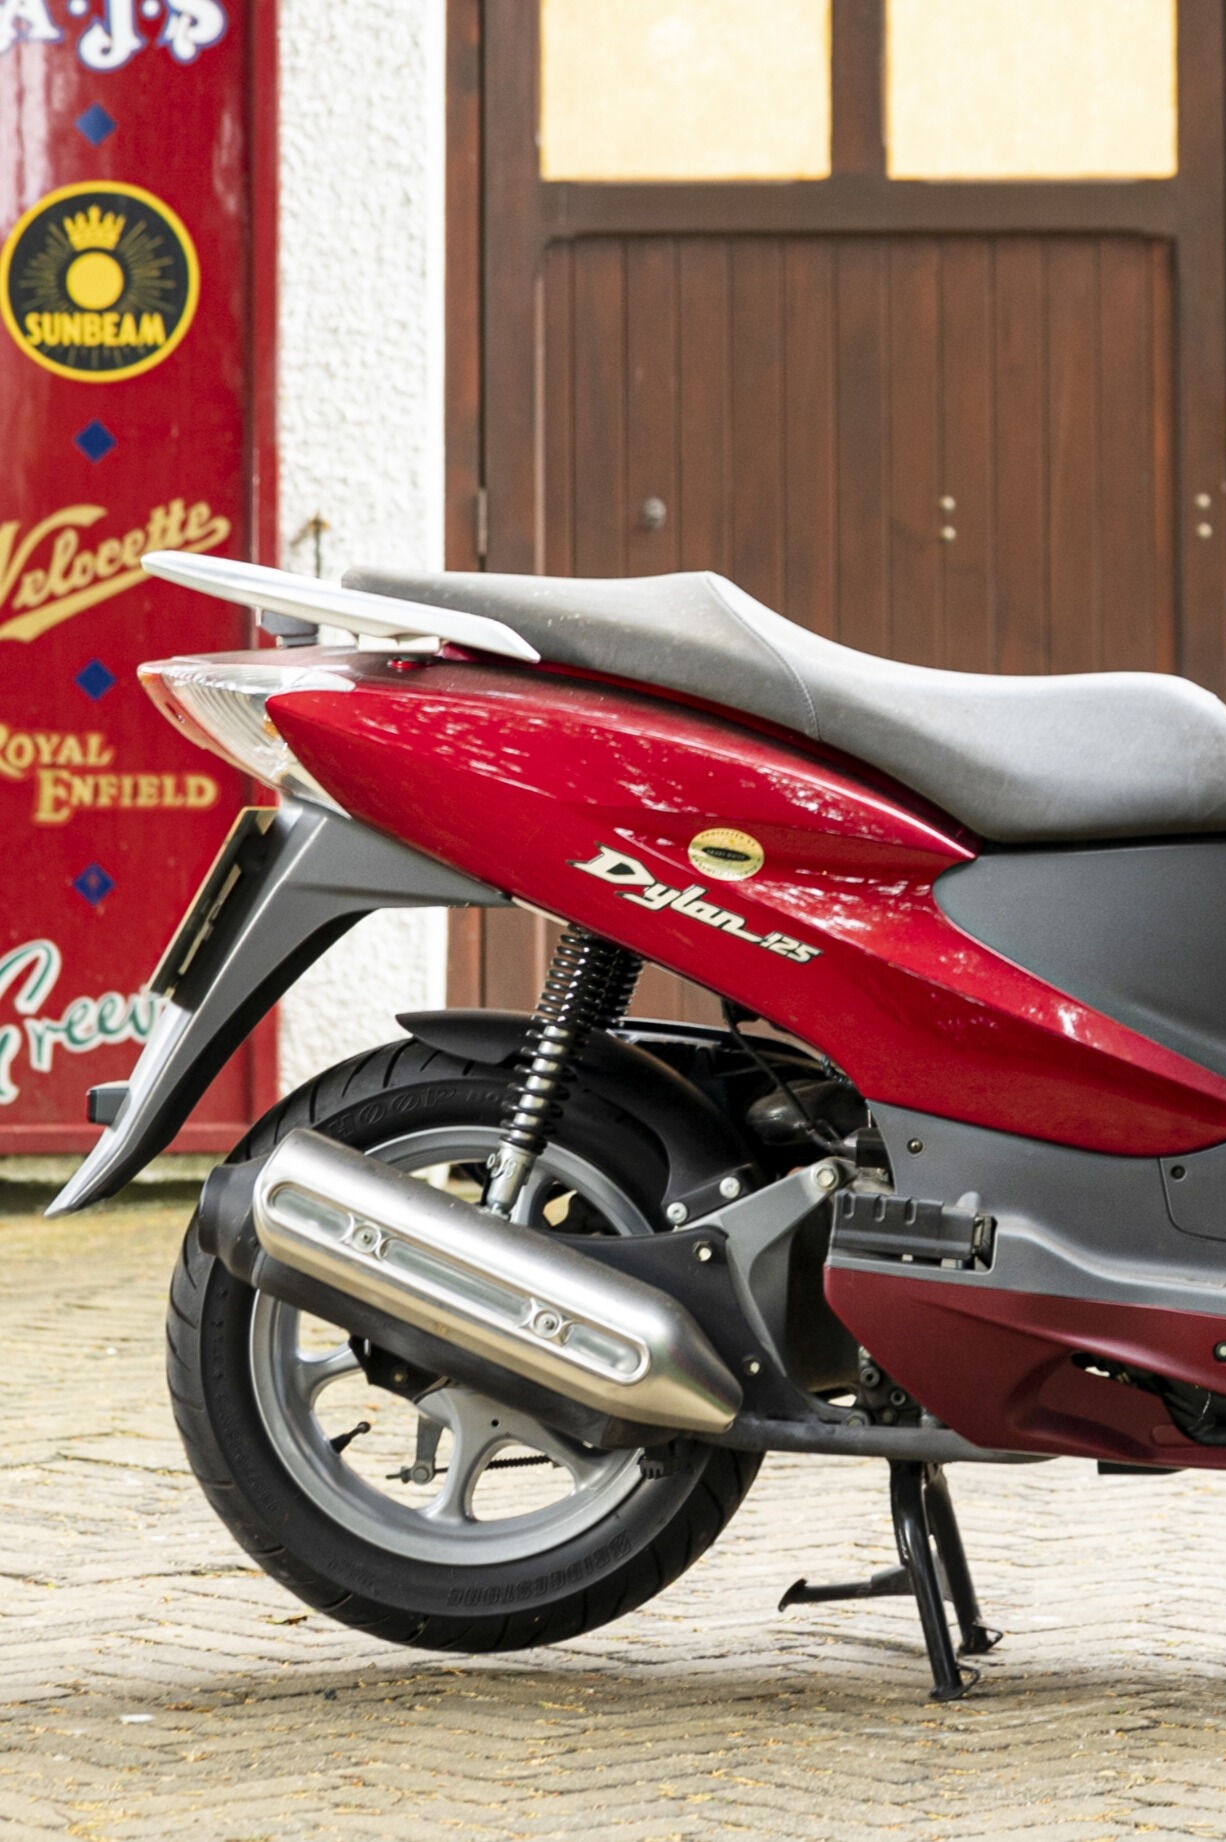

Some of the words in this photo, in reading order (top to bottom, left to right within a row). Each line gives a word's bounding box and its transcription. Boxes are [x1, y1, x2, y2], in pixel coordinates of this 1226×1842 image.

[24, 313, 166, 347] SUNBEAM
[35, 768, 218, 823] ENFIELD
[566, 840, 763, 943] Dylan
[759, 931, 824, 964] 125
